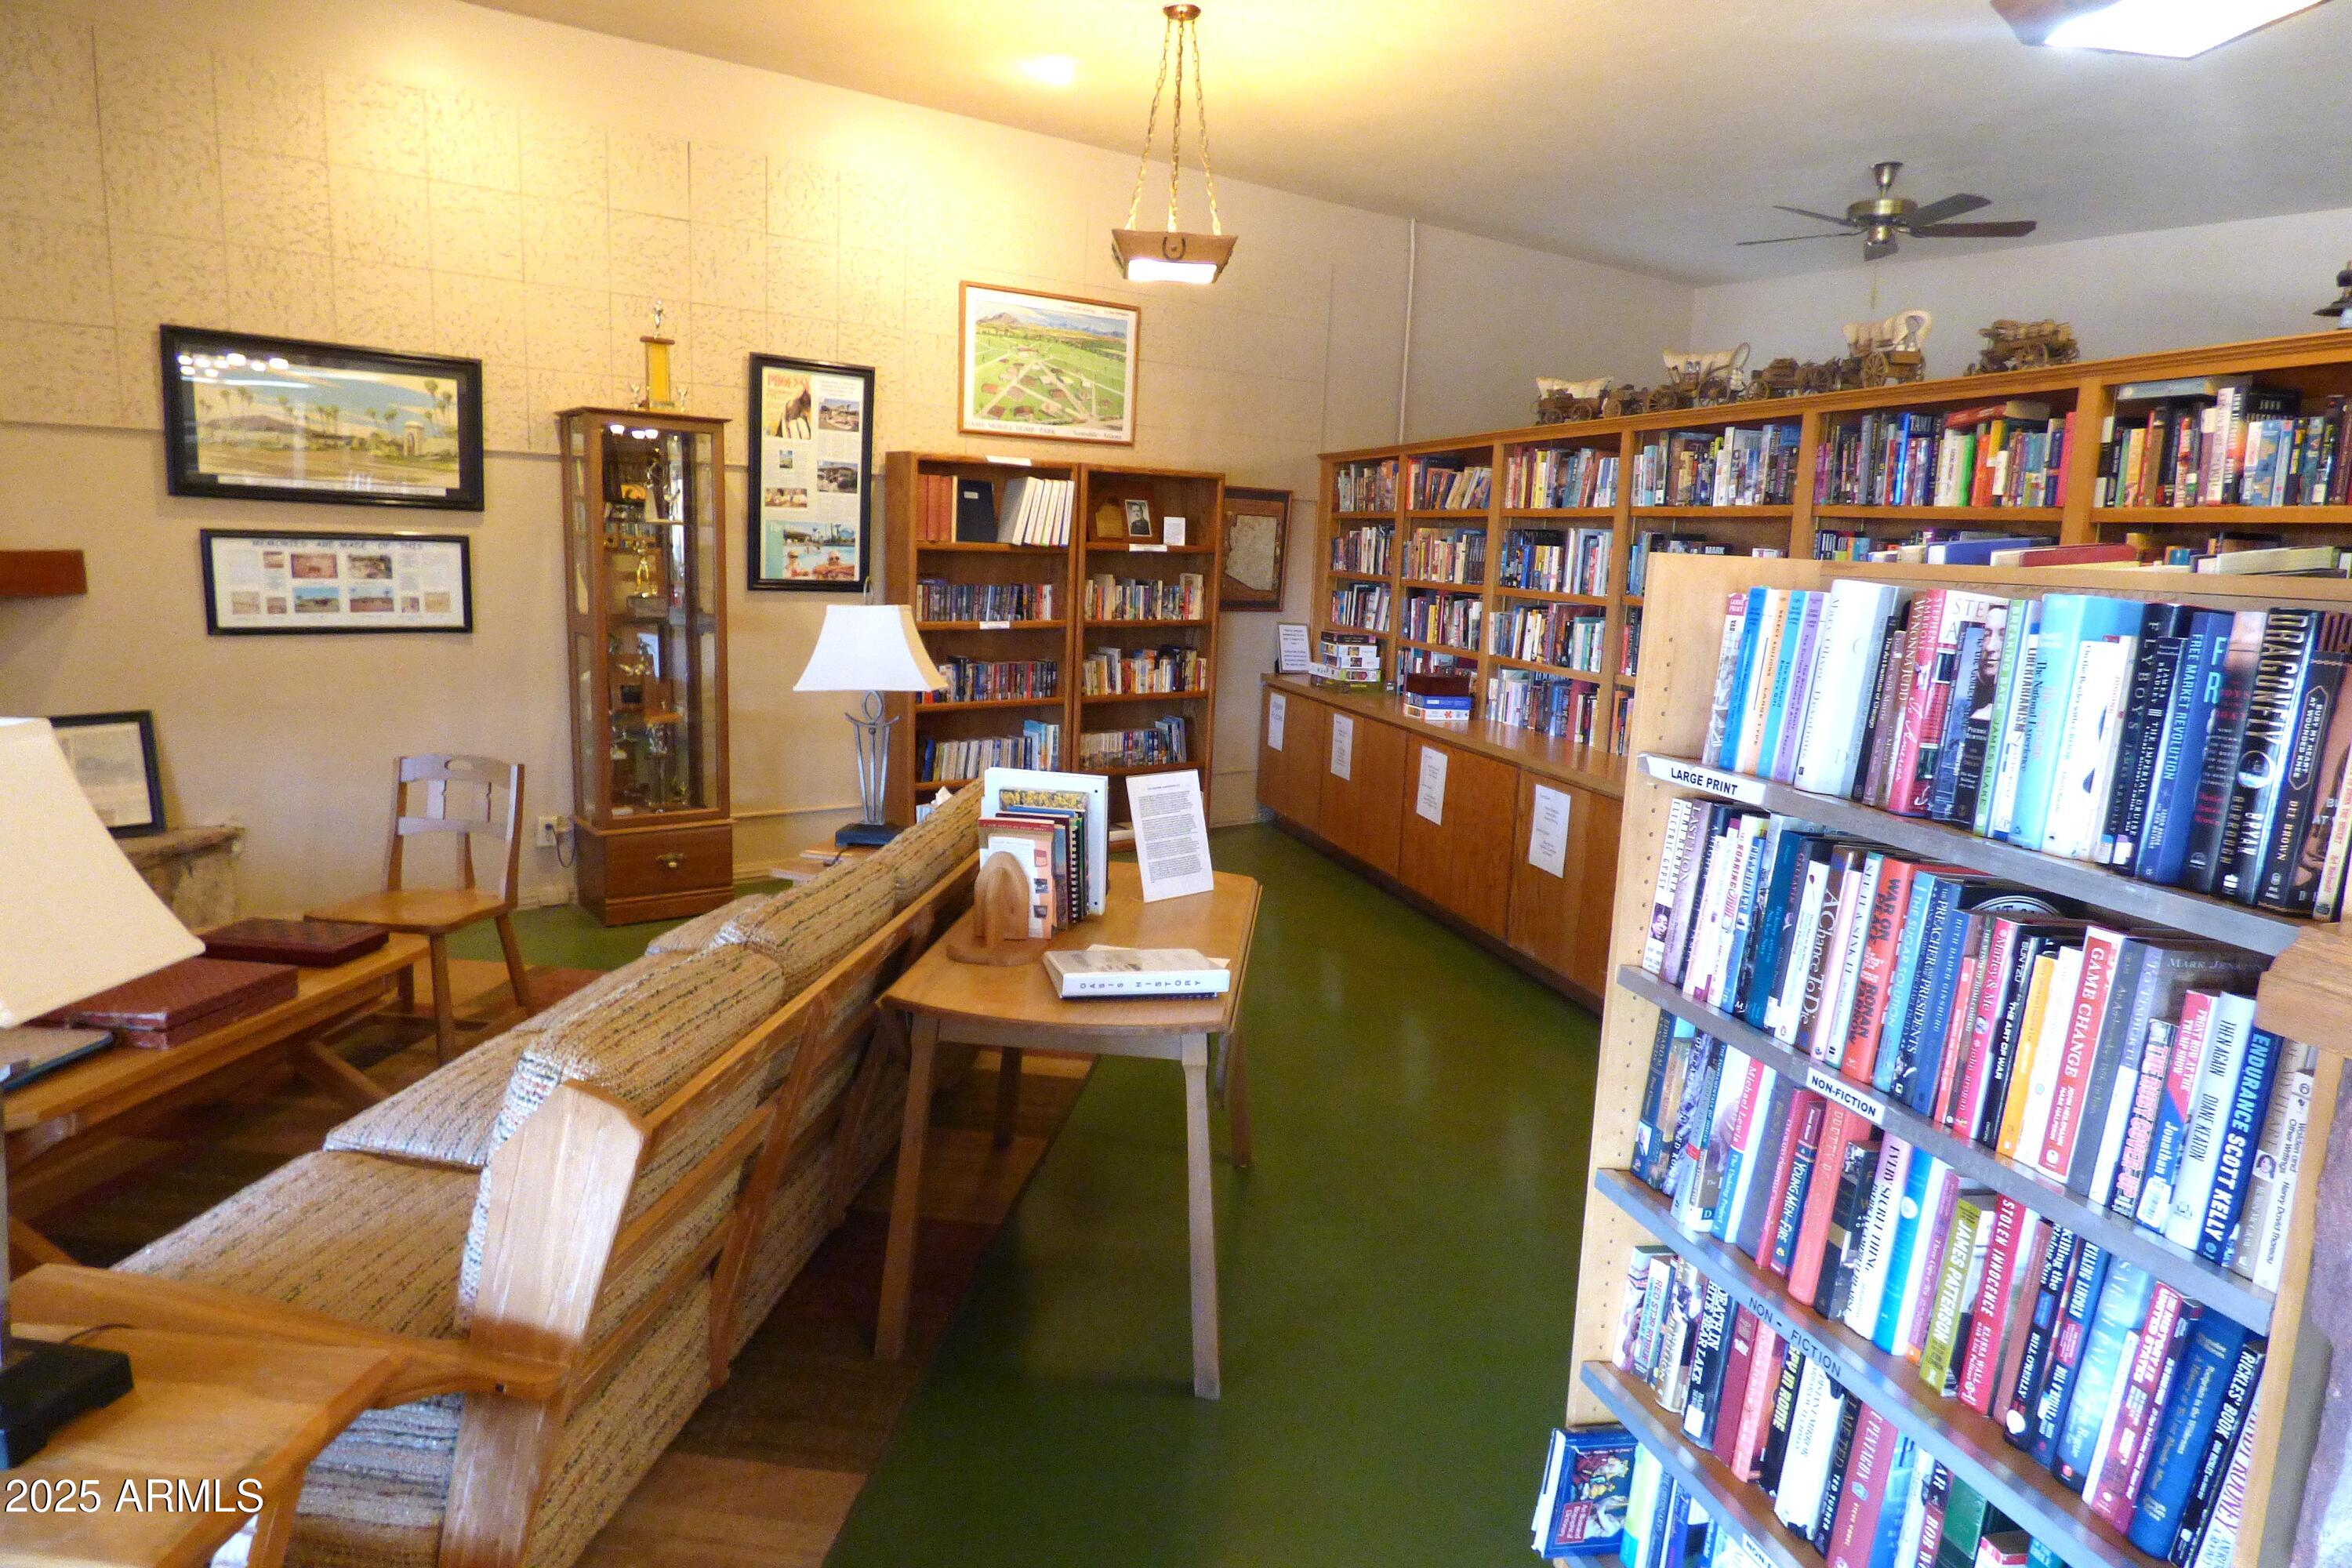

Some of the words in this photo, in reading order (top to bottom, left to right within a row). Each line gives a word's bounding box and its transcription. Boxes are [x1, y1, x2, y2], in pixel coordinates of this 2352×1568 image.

[1903, 598, 1925, 666] WYNONNA
[1916, 596, 1933, 650] AMBROSE
[1928, 597, 1943, 641] STEPHEN
[2187, 632, 2205, 662] FREE
[1895, 666, 1913, 702] JUDD
[1994, 675, 2009, 711] BACK
[2012, 647, 2040, 733] LIBERTARIANISM
[2126, 619, 2160, 731] FLYBOYS
[2176, 662, 2198, 709] MARKET
[2245, 615, 2308, 746] DRAGONFLY
[1867, 699, 1880, 730] Chicago
[2027, 678, 2042, 717] National
[2307, 695, 2317, 708] AT
[2313, 702, 2322, 722] BURY
[1984, 718, 2002, 761] JAMES
[2147, 720, 2161, 742] THE
[2161, 711, 2188, 781] REVOLUTION
[2298, 709, 2314, 753] WOUNDED
[2308, 729, 2317, 742] MY
[1893, 719, 1921, 784] America
[1951, 741, 1965, 777] Anderson
[2292, 755, 2304, 779] KNEE
[2301, 743, 2314, 773] HEART
[1671, 767, 1703, 787] LARGE
[1706, 776, 1738, 796] PRINT
[1976, 764, 1995, 804] BLAKE
[2136, 745, 2155, 795] IMPERIAL
[1664, 800, 1681, 853] ELECTRIC
[1686, 805, 1701, 841] LAST
[2127, 799, 2143, 837] CRUISE
[2285, 798, 2299, 819] DEE
[2214, 793, 2249, 865] BURROUGH
[2234, 808, 2266, 856] BRYAN
[2274, 822, 2294, 861] BROWN
[1656, 857, 1670, 891] GYPSY
[1677, 845, 1693, 884] LION
[1728, 843, 1744, 889] ROARING
[1821, 888, 1841, 910] A
[1882, 877, 1900, 915] WAR
[1909, 894, 1922, 918] THE
[1808, 909, 1838, 974] Chance
[1876, 916, 1893, 942] ON
[1900, 918, 1918, 964] SUGAR
[1924, 899, 1948, 967] PREACHER
[1950, 916, 1964, 946] RUTH
[1943, 946, 1958, 982] BADER
[1987, 937, 2006, 978] Marley
[2016, 939, 2029, 964] SUN
[1804, 971, 1825, 995] To
[2013, 963, 2024, 983] TZU
[2081, 946, 2104, 1000] GAME
[1798, 992, 1820, 1027] Die
[1857, 982, 1879, 1039] RONAN
[1886, 967, 1907, 1028] SOLUTION
[1904, 977, 1932, 1054] PRESIDENTS
[1931, 982, 1949, 1033] GINSBURG
[1980, 989, 1995, 1013] Me
[2005, 1000, 2017, 1021] THE
[2001, 1020, 2013, 1044] ART
[2063, 1000, 2092, 1079] CHANGE
[2177, 1017, 2193, 1050] TRUMP
[2191, 1008, 2208, 1043] FRONT
[2214, 1018, 2236, 1047] THEN
[1691, 1036, 1703, 1056] OFF
[1997, 1041, 2008, 1057] OF
[2141, 1041, 2169, 1076] THE
[2172, 1048, 2187, 1074] SHOW
[2187, 1042, 2200, 1059] ROW
[2208, 1045, 2229, 1078] AGAIN
[1682, 1058, 1698, 1100] CAMERA
[1992, 1055, 2005, 1080] WAR
[2180, 1073, 2193, 1091] THE
[2184, 1060, 2196, 1074] AT
[2230, 1033, 2270, 1133] ENDURANCE
[1738, 1065, 1757, 1110] Michael
[1811, 1075, 1877, 1116] NON-FICTION
[1955, 1073, 1974, 1112] grogan
[2055, 1086, 2067, 1108] MARK
[2061, 1085, 2076, 1106] JOHN
[2130, 1073, 2164, 1122] RUBY
[2196, 1092, 2219, 1123] DIANE
[1731, 1112, 1746, 1143] Lewis
[2187, 1121, 2212, 1162] KEATON
[2285, 1117, 2297, 1142] Other
[2292, 1120, 2307, 1153] Walden
[1729, 1153, 1738, 1167] The
[1882, 1145, 1900, 1183] EVERY
[2113, 1115, 2154, 1199] COVER-UP
[2153, 1120, 2180, 1175] Jonathan
[2214, 1132, 2248, 1190] SCOTT
[2278, 1142, 2292, 1174] Writings
[2288, 1153, 2300, 1173] and
[1722, 1167, 1734, 1197] Undoing
[1787, 1161, 1806, 1194] YOUNG
[2277, 1180, 2291, 1205] Henry
[1715, 1198, 1728, 1224] Project
[1782, 1192, 1798, 1217] MEN
[1871, 1185, 1892, 1230] SECRET
[1992, 1198, 2018, 1247] STOLEN
[2201, 1188, 2234, 1241] KELLY
[2272, 1204, 2285, 1233] David
[1774, 1219, 1791, 1244] FIRE
[1929, 1237, 1943, 1261] Three
[1948, 1220, 1976, 1269] JAMES
[2045, 1222, 2063, 1261] Rising
[2051, 1226, 2074, 1271] Killing
[1925, 1261, 1936, 1277] Cups
[2038, 1260, 2053, 1285] Sun
[2076, 1241, 2100, 1280] KILLING
[1652, 1278, 1664, 1300] RED
[1976, 1247, 2008, 1317] INNOCENCE
[2046, 1269, 2065, 1291] the
[1646, 1300, 1660, 1327] STAR
[1707, 1286, 1733, 1334] DEATH
[1931, 1266, 1965, 1344] PATTERSON
[2067, 1278, 2091, 1319] LINCOLN
[1639, 1327, 1656, 1363] ROGUE
[1693, 1311, 1715, 1347] BEAR
[1704, 1330, 1722, 1351] IN
[1749, 1297, 1773, 1323] NON
[1791, 1329, 1841, 1377] FICTION
[1975, 1325, 1991, 1358] ELISSA
[2027, 1331, 2042, 1353] BILL
[1686, 1345, 1709, 1386] LAKE
[1783, 1345, 1802, 1373] SPY
[1970, 1359, 1984, 1384] WALL
[2016, 1352, 2037, 1399] O'REILLY
[2053, 1363, 2069, 1384] BILL
[1780, 1369, 1796, 1389] IN
[2224, 1348, 2255, 1407] RICKLES'
[1769, 1385, 1795, 1432] ROME
[2212, 1400, 2240, 1440] BOOK
[1850, 1419, 1885, 1481] PENTAGON
[1828, 1472, 1842, 1492] TED
[2213, 1459, 2249, 1535] ROONEY
[1818, 1493, 1838, 1530] TURNER
[1915, 1512, 1944, 1549] BOB
